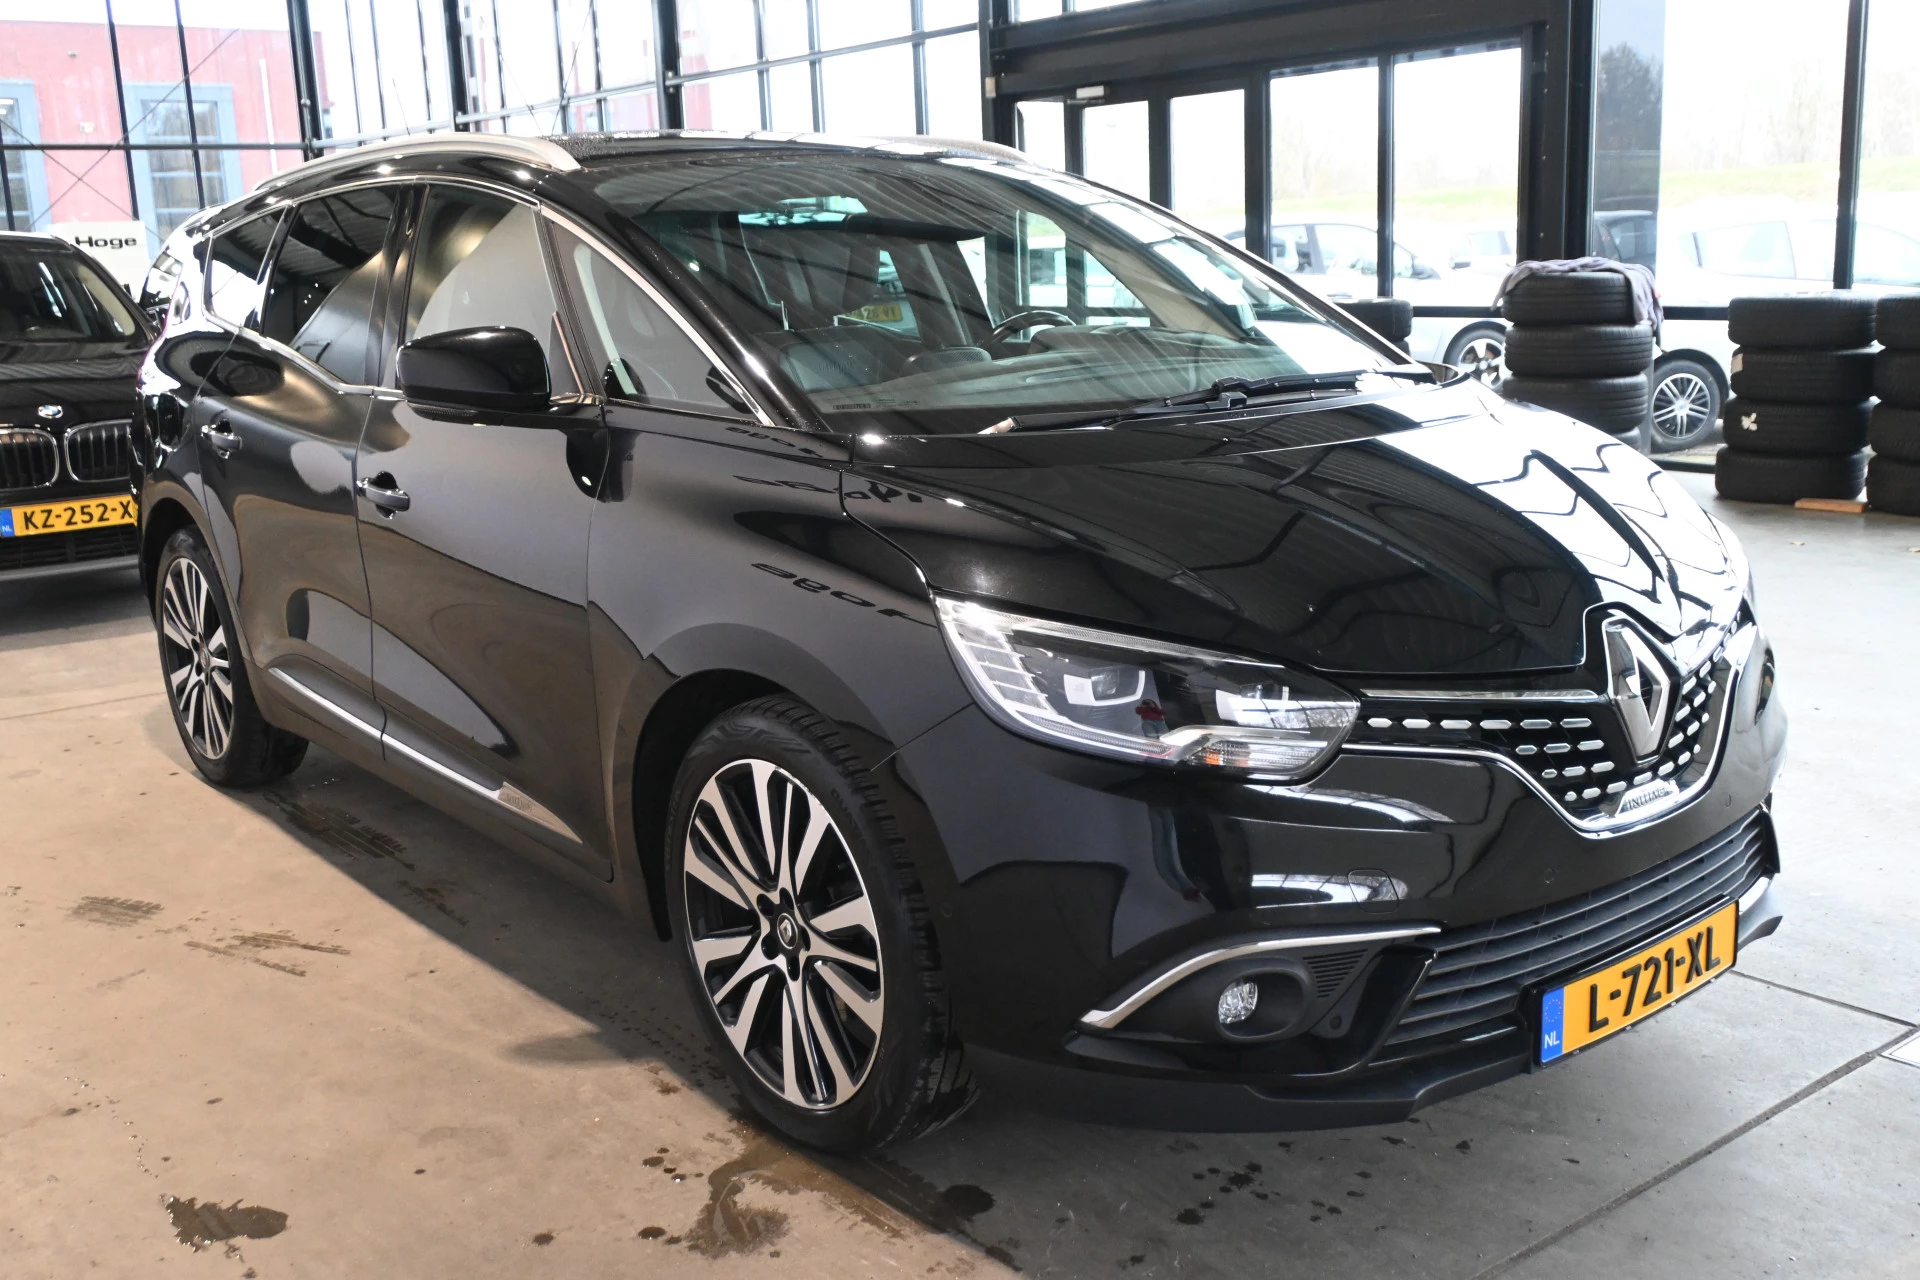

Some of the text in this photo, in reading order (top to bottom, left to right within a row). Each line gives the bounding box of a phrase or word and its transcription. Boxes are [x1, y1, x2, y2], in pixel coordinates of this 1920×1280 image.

[75, 236, 137, 249] Hoge
[23, 500, 133, 530] KZ-252-X
[1589, 925, 1721, 1032] L-721-XL
[1544, 1030, 1560, 1049] NL
